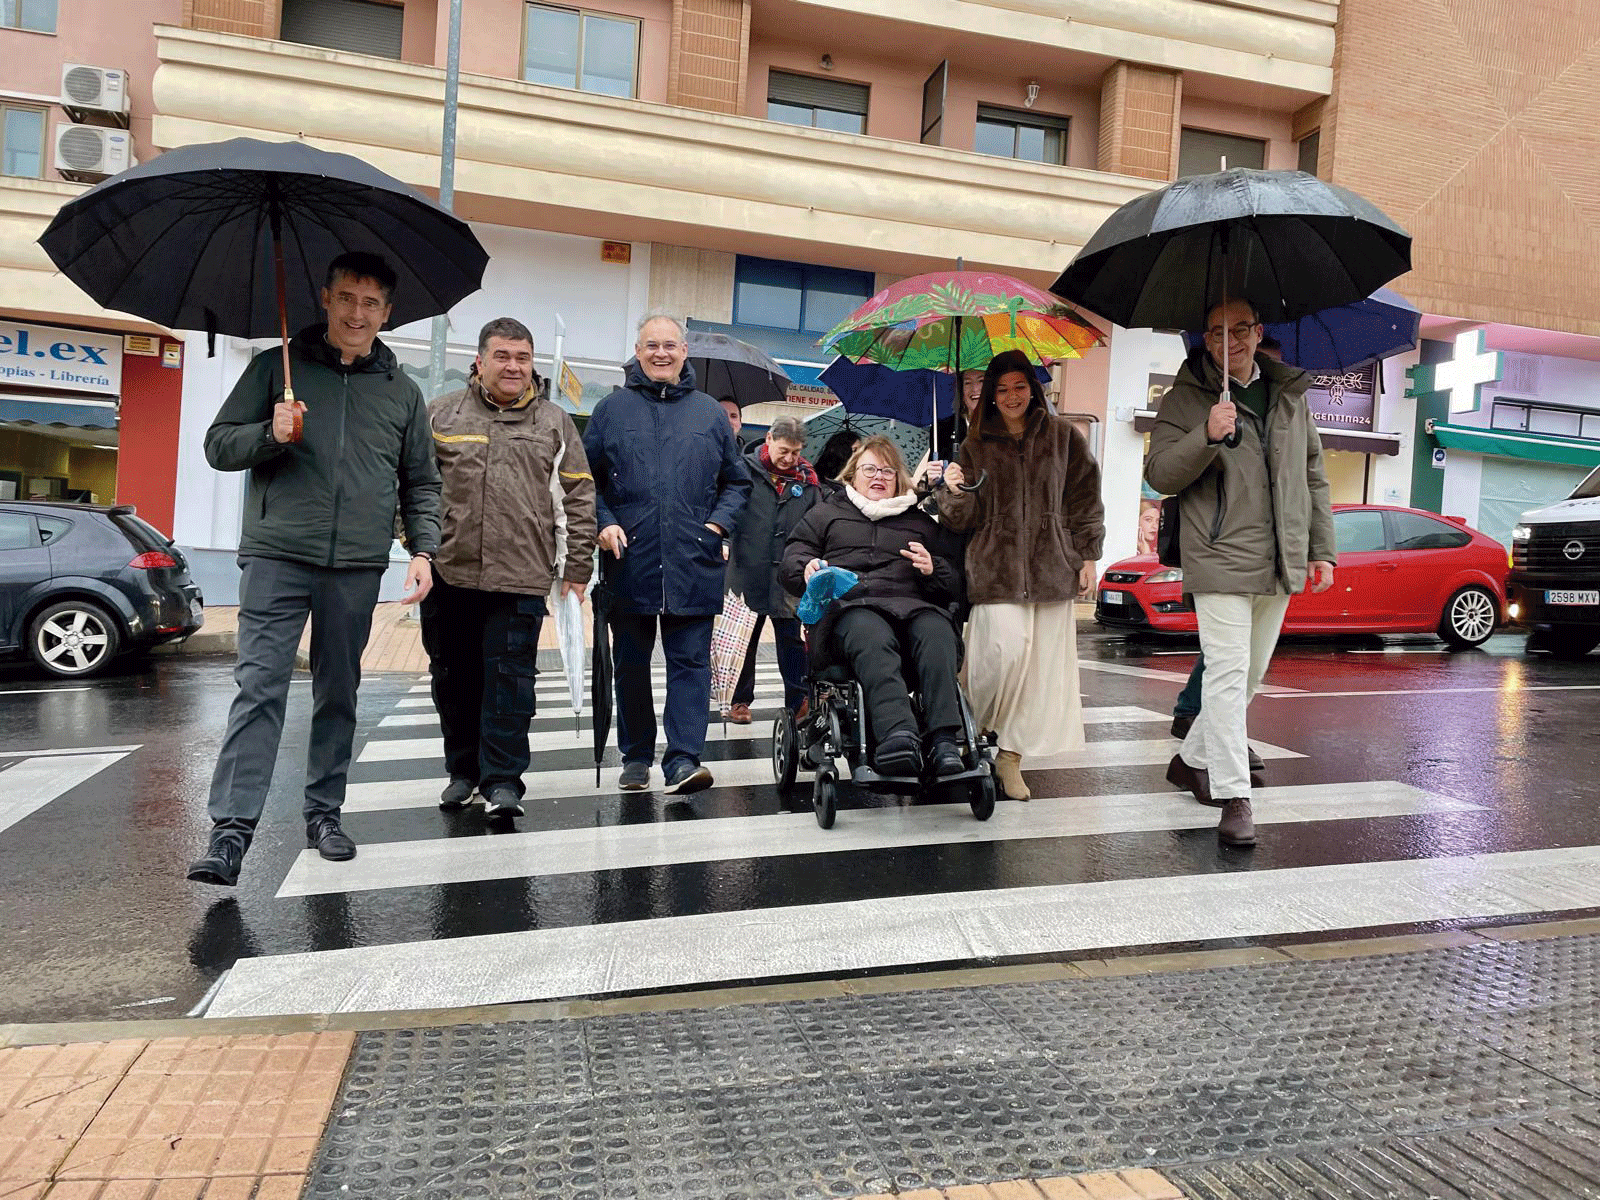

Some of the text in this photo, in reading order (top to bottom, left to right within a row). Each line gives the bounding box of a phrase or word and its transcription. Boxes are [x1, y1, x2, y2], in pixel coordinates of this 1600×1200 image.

[50, 369, 110, 386] Librería
[786, 395, 806, 403] IENE
[808, 397, 819, 405] SU
[1312, 412, 1371, 424] GENTINA24
[1550, 592, 1597, 603] 2598 MXV
